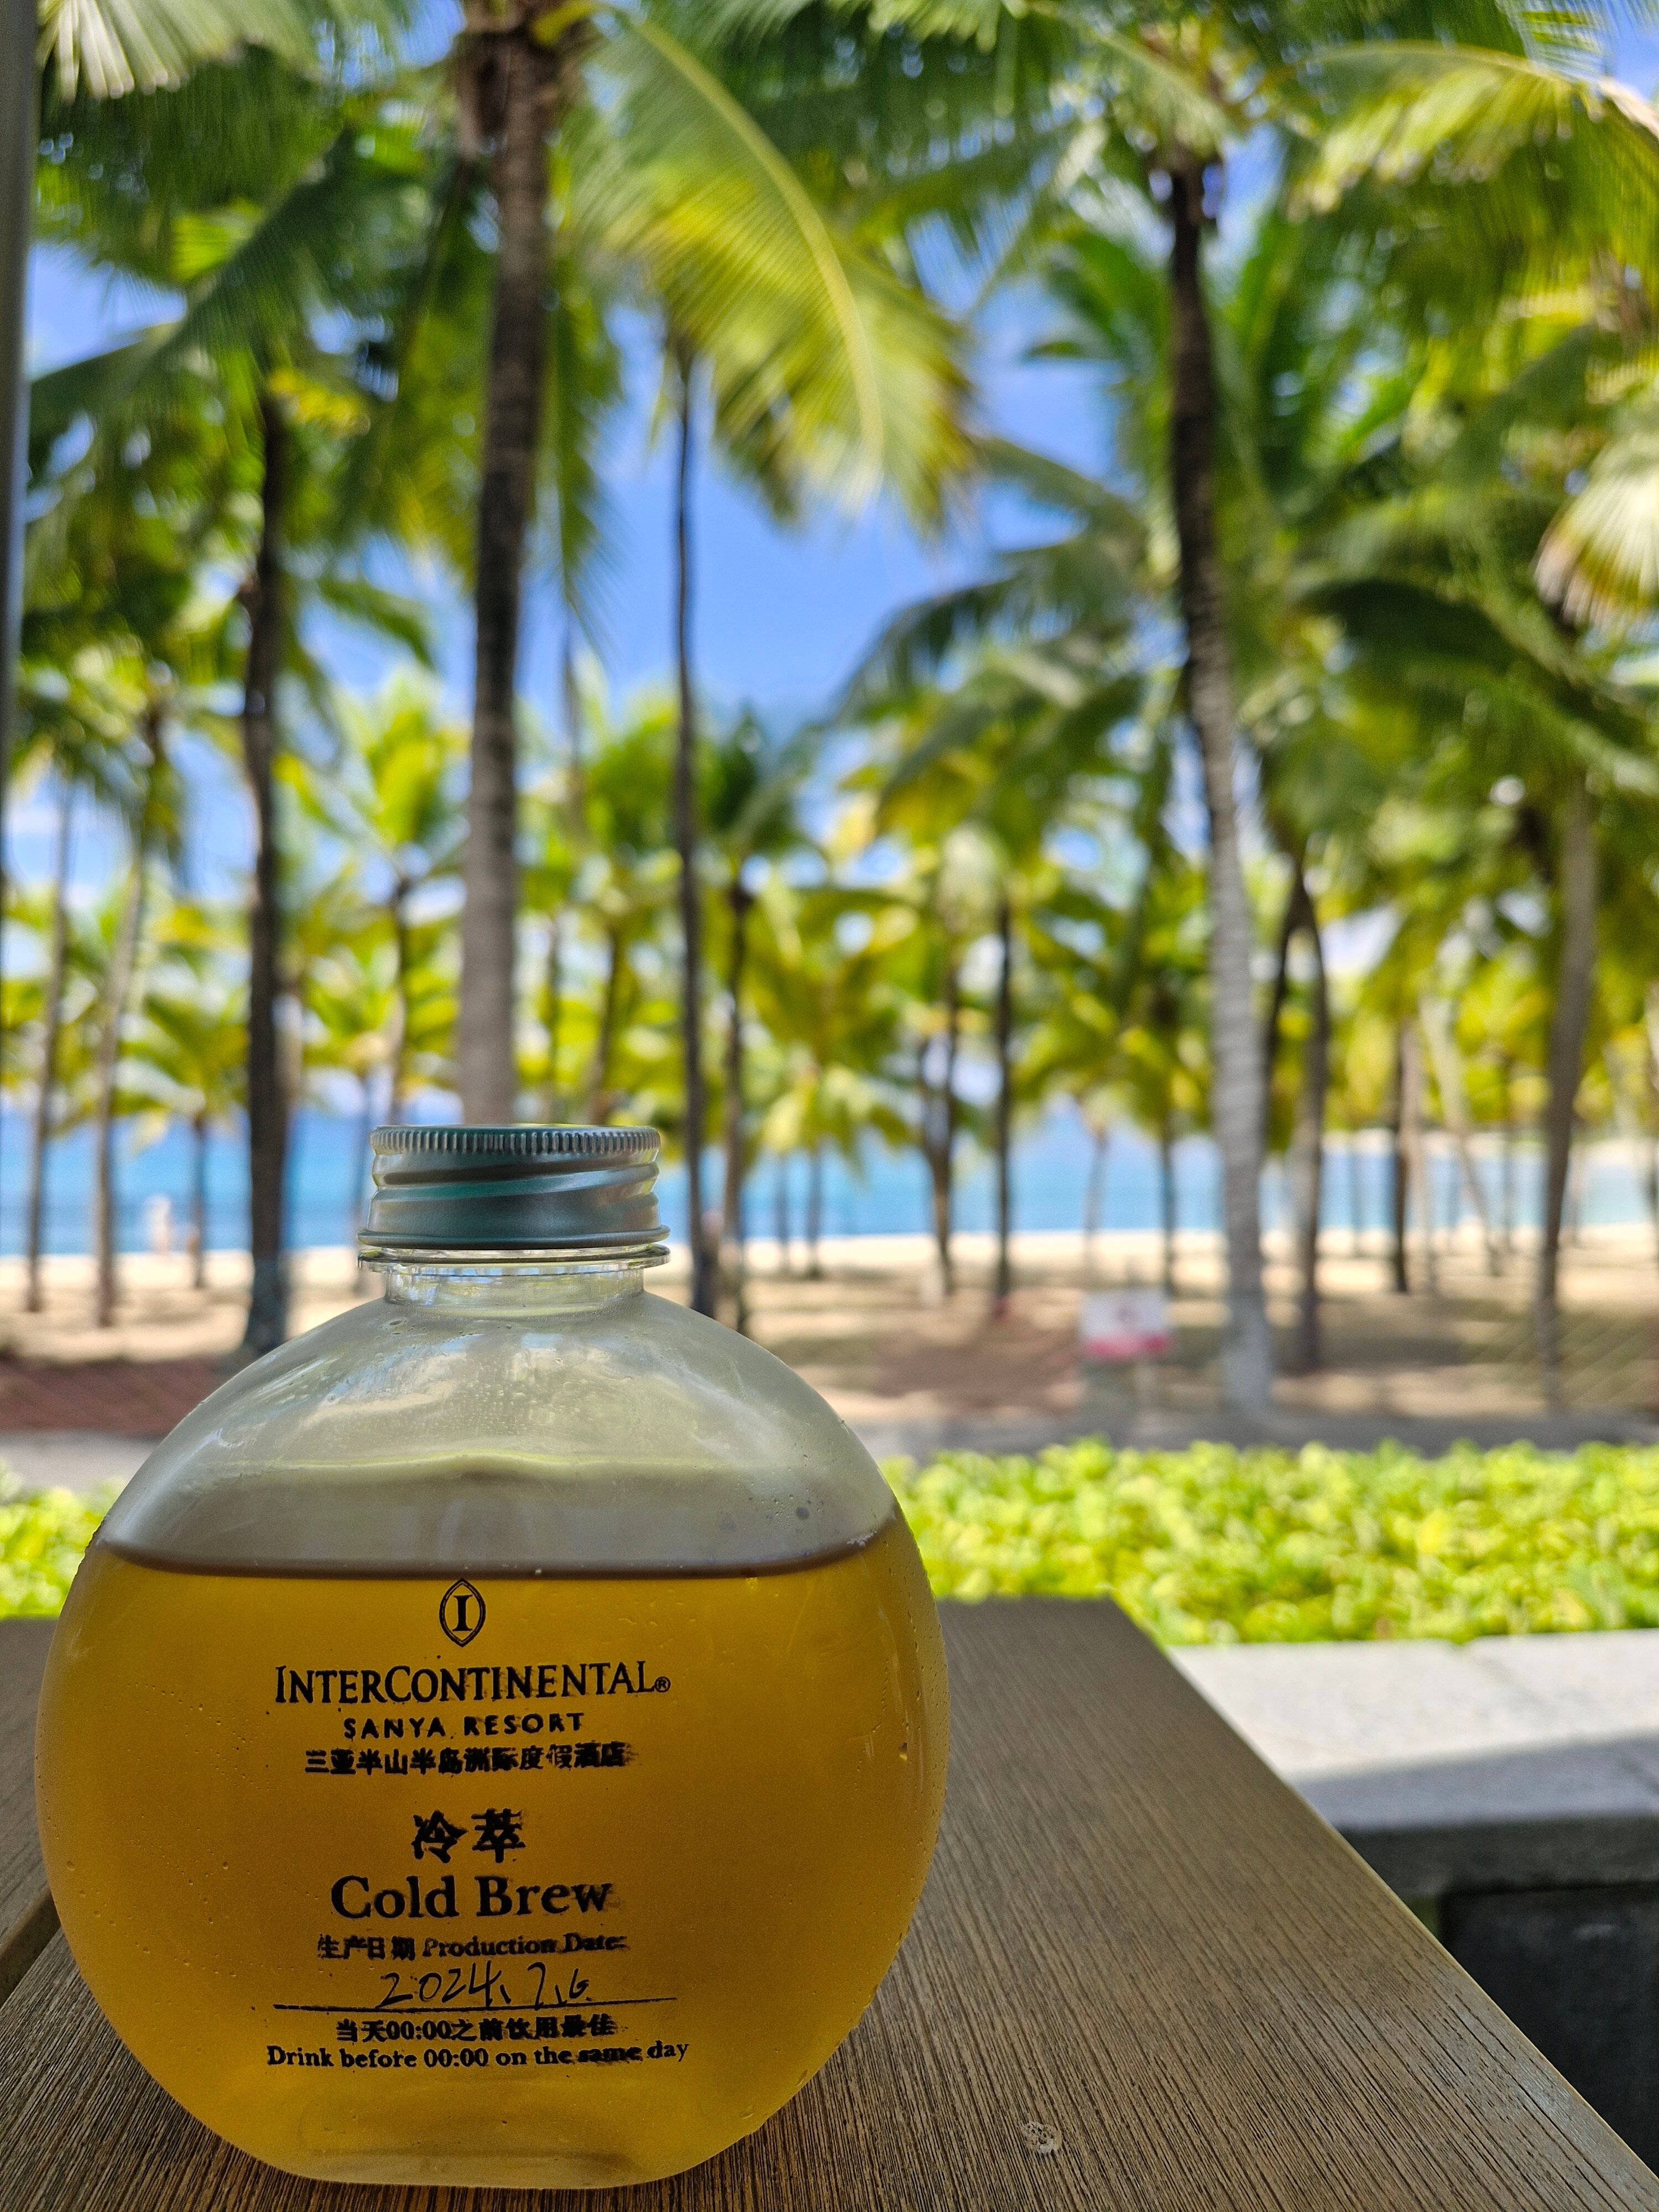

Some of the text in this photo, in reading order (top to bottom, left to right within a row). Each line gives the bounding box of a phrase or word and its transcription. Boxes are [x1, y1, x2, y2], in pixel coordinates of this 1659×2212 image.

[343, 1712, 585, 1739] SANYA RESORT
[305, 1742, 632, 1775] 三亚半山半岛洲际度假酒店
[411, 1807, 526, 1863] 冷萃
[332, 1875, 618, 1918] Cold Brew
[317, 1933, 416, 1960] 生产日期
[422, 1935, 556, 1958] Production
[267, 2039, 690, 2069] Drink before 00:00 on the same day
